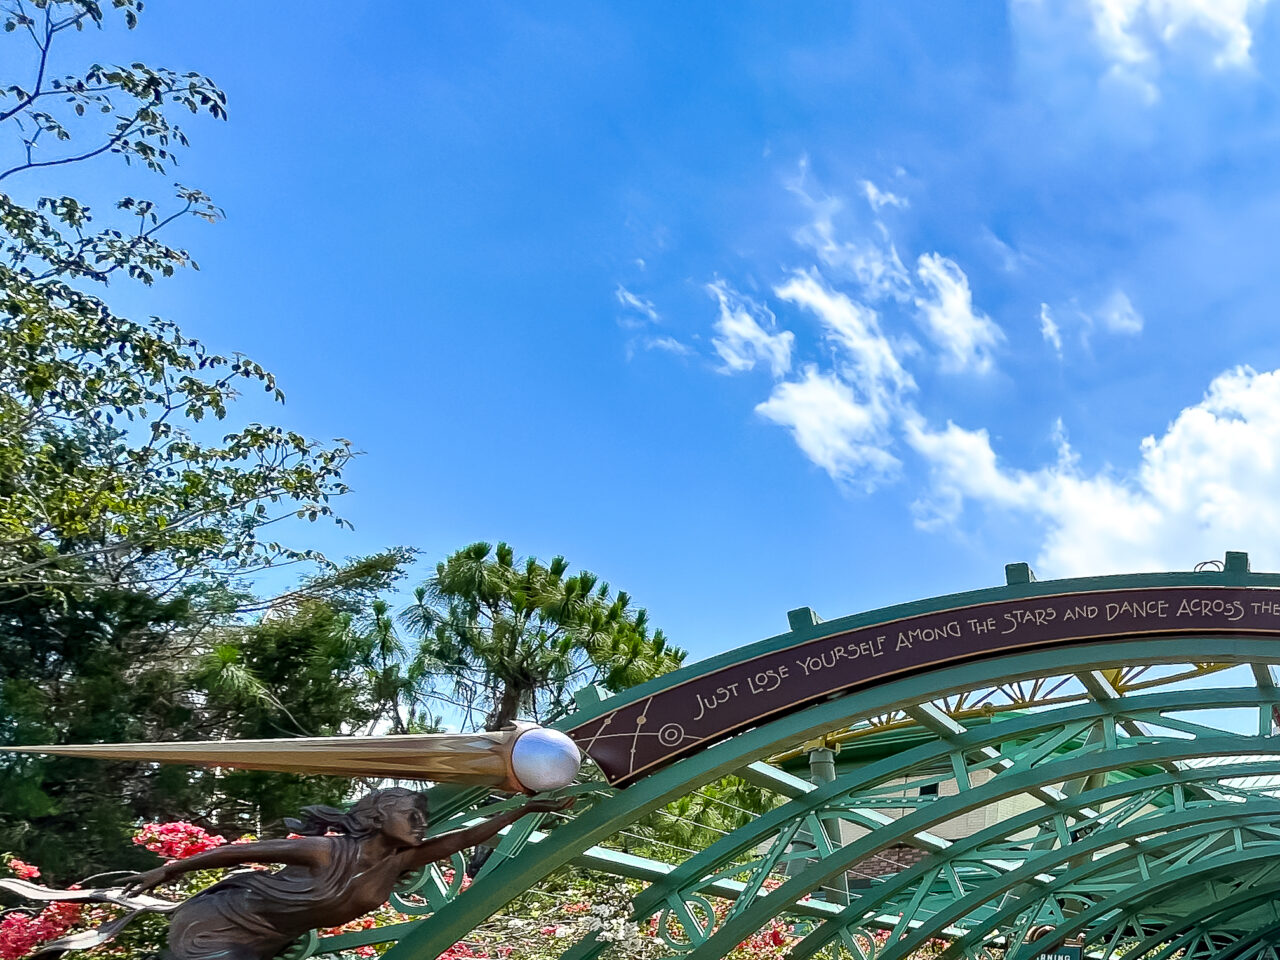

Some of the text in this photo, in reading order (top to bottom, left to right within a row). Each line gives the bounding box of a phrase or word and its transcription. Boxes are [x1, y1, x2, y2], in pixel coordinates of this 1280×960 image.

[694, 683, 738, 721] JUST
[748, 666, 789, 694] LOSE
[796, 636, 886, 676] YOURSELF
[894, 621, 961, 651] AMONG
[968, 618, 996, 635] THE
[1002, 608, 1057, 633] STARS
[1064, 606, 1098, 620] AND
[1106, 601, 1169, 621] DANCE
[1176, 599, 1244, 621] ACROSS
[1251, 602, 1280, 616] THE
